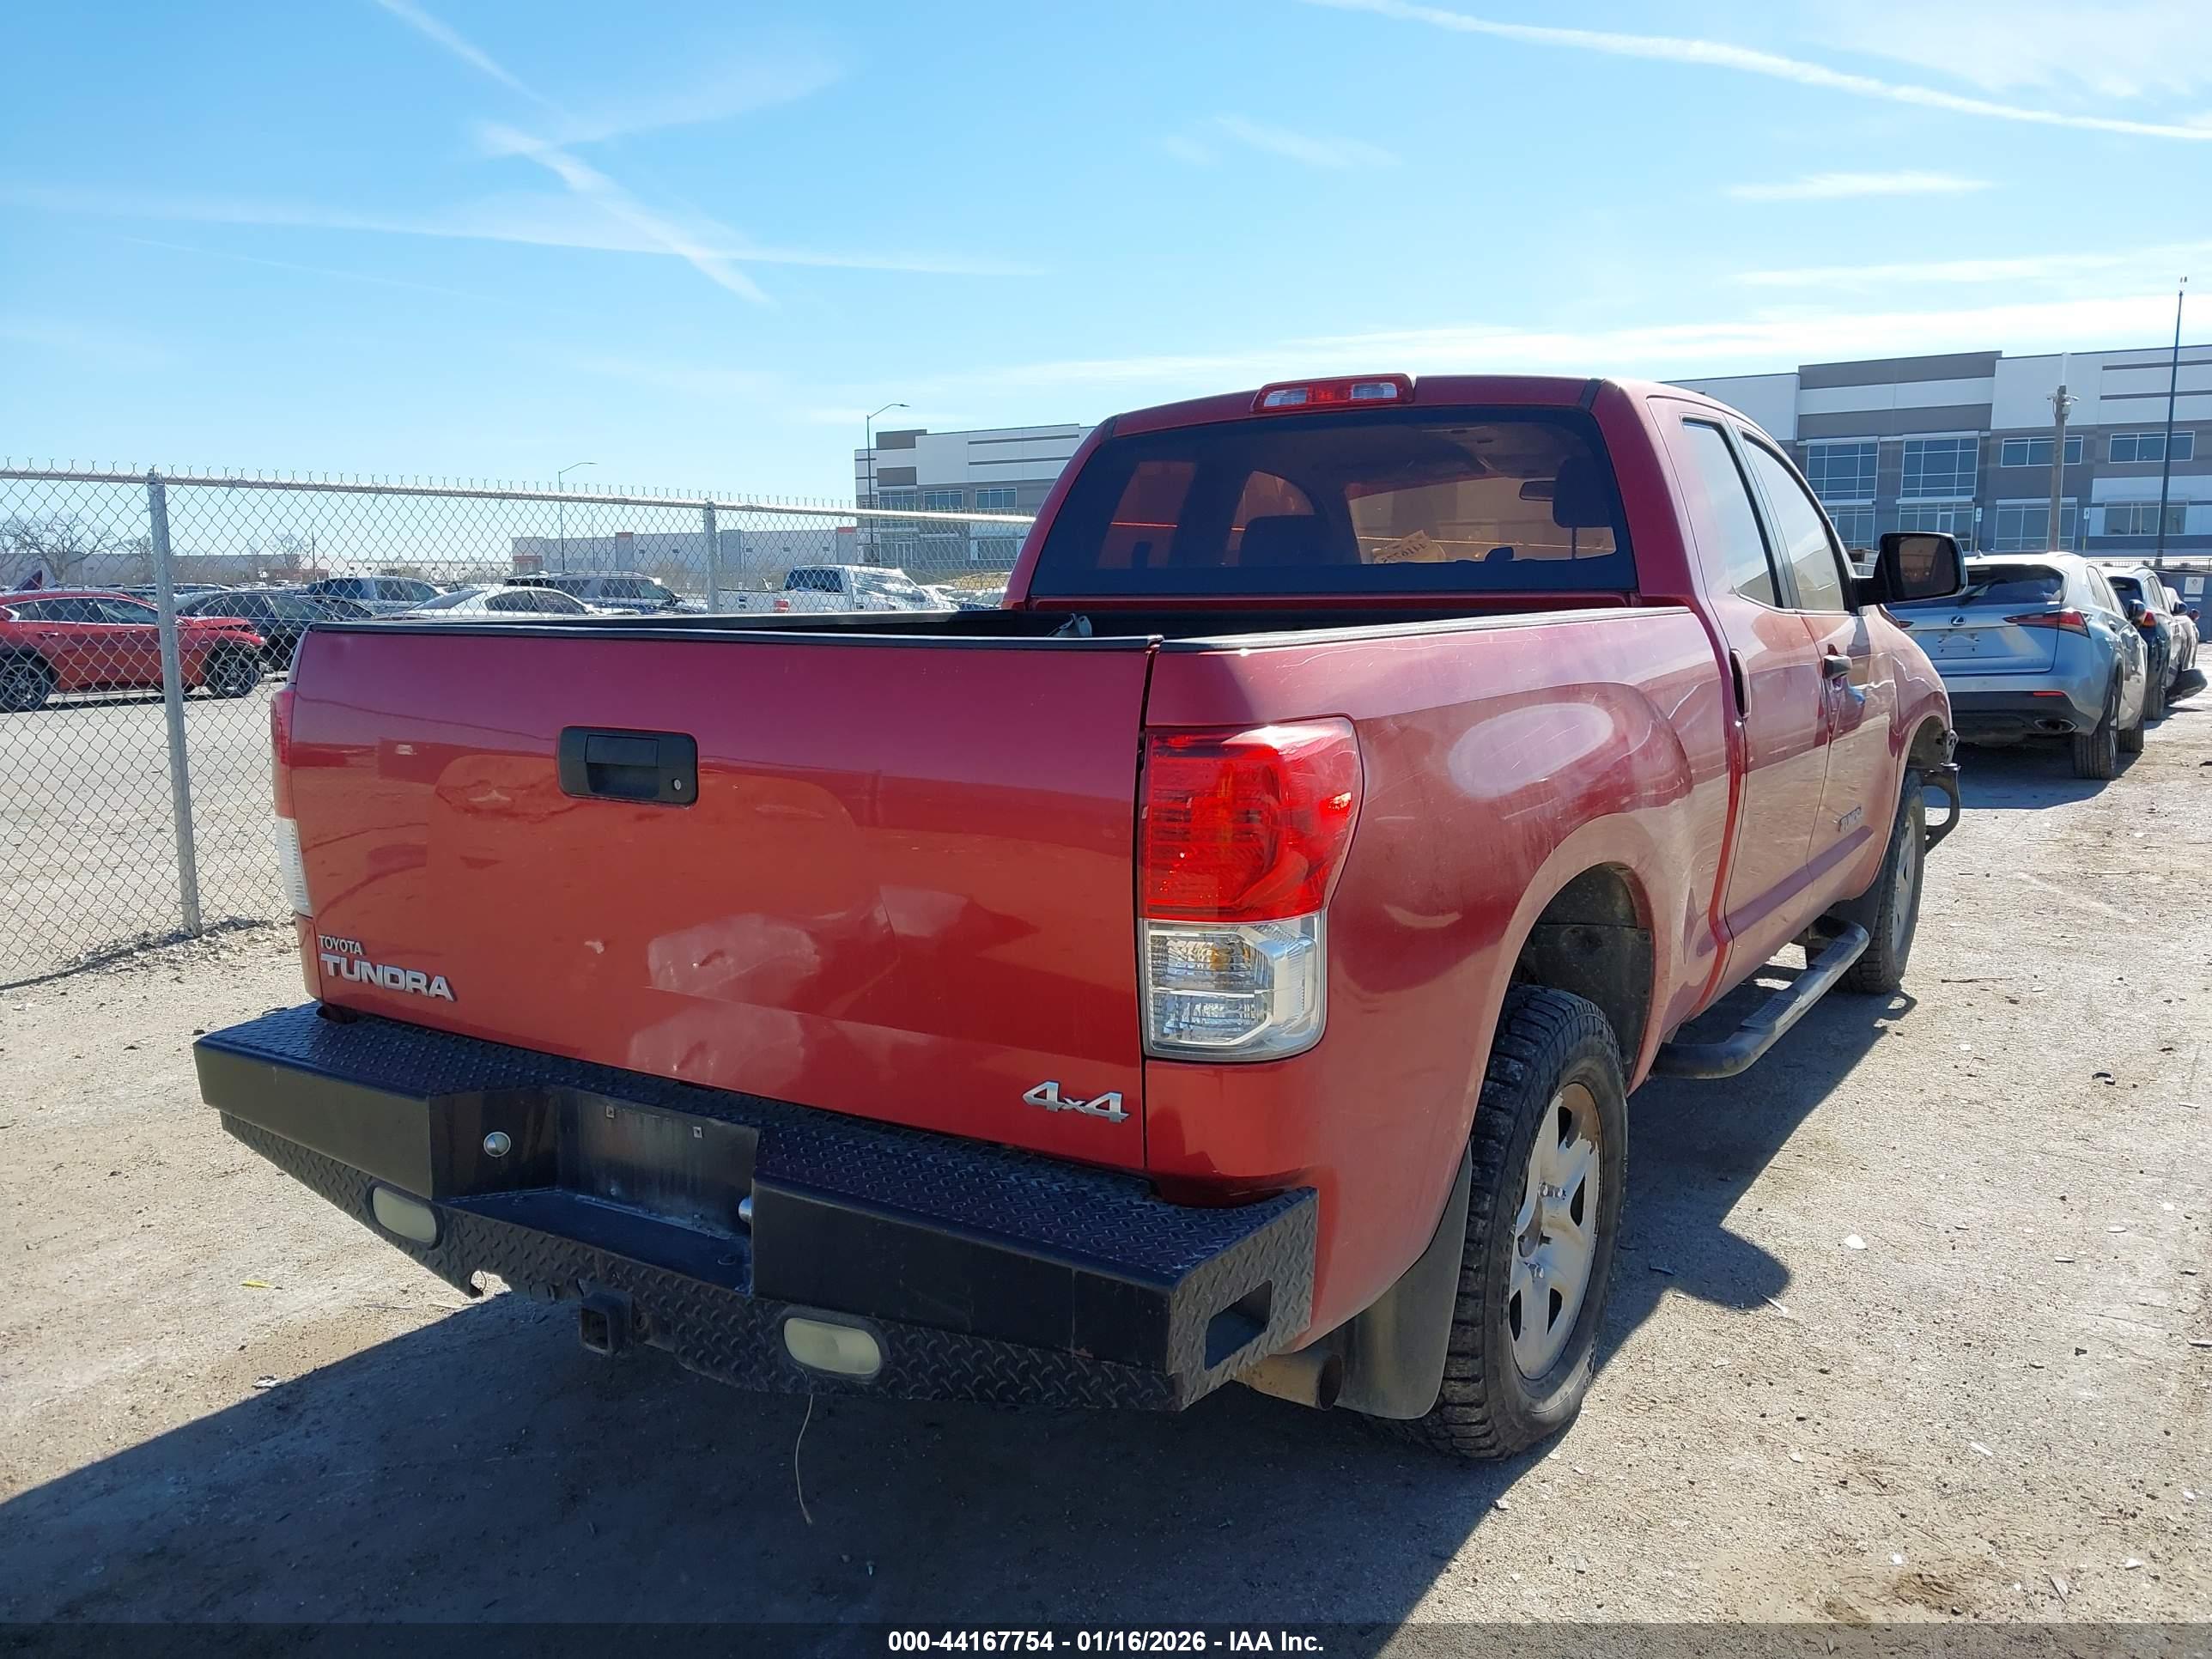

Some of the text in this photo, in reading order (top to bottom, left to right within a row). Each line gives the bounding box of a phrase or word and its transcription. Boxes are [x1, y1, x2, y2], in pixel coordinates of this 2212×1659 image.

[319, 935, 363, 956] TOYOTA
[320, 953, 455, 1002] TUNDRA
[1022, 1080, 1130, 1123] 4x4
